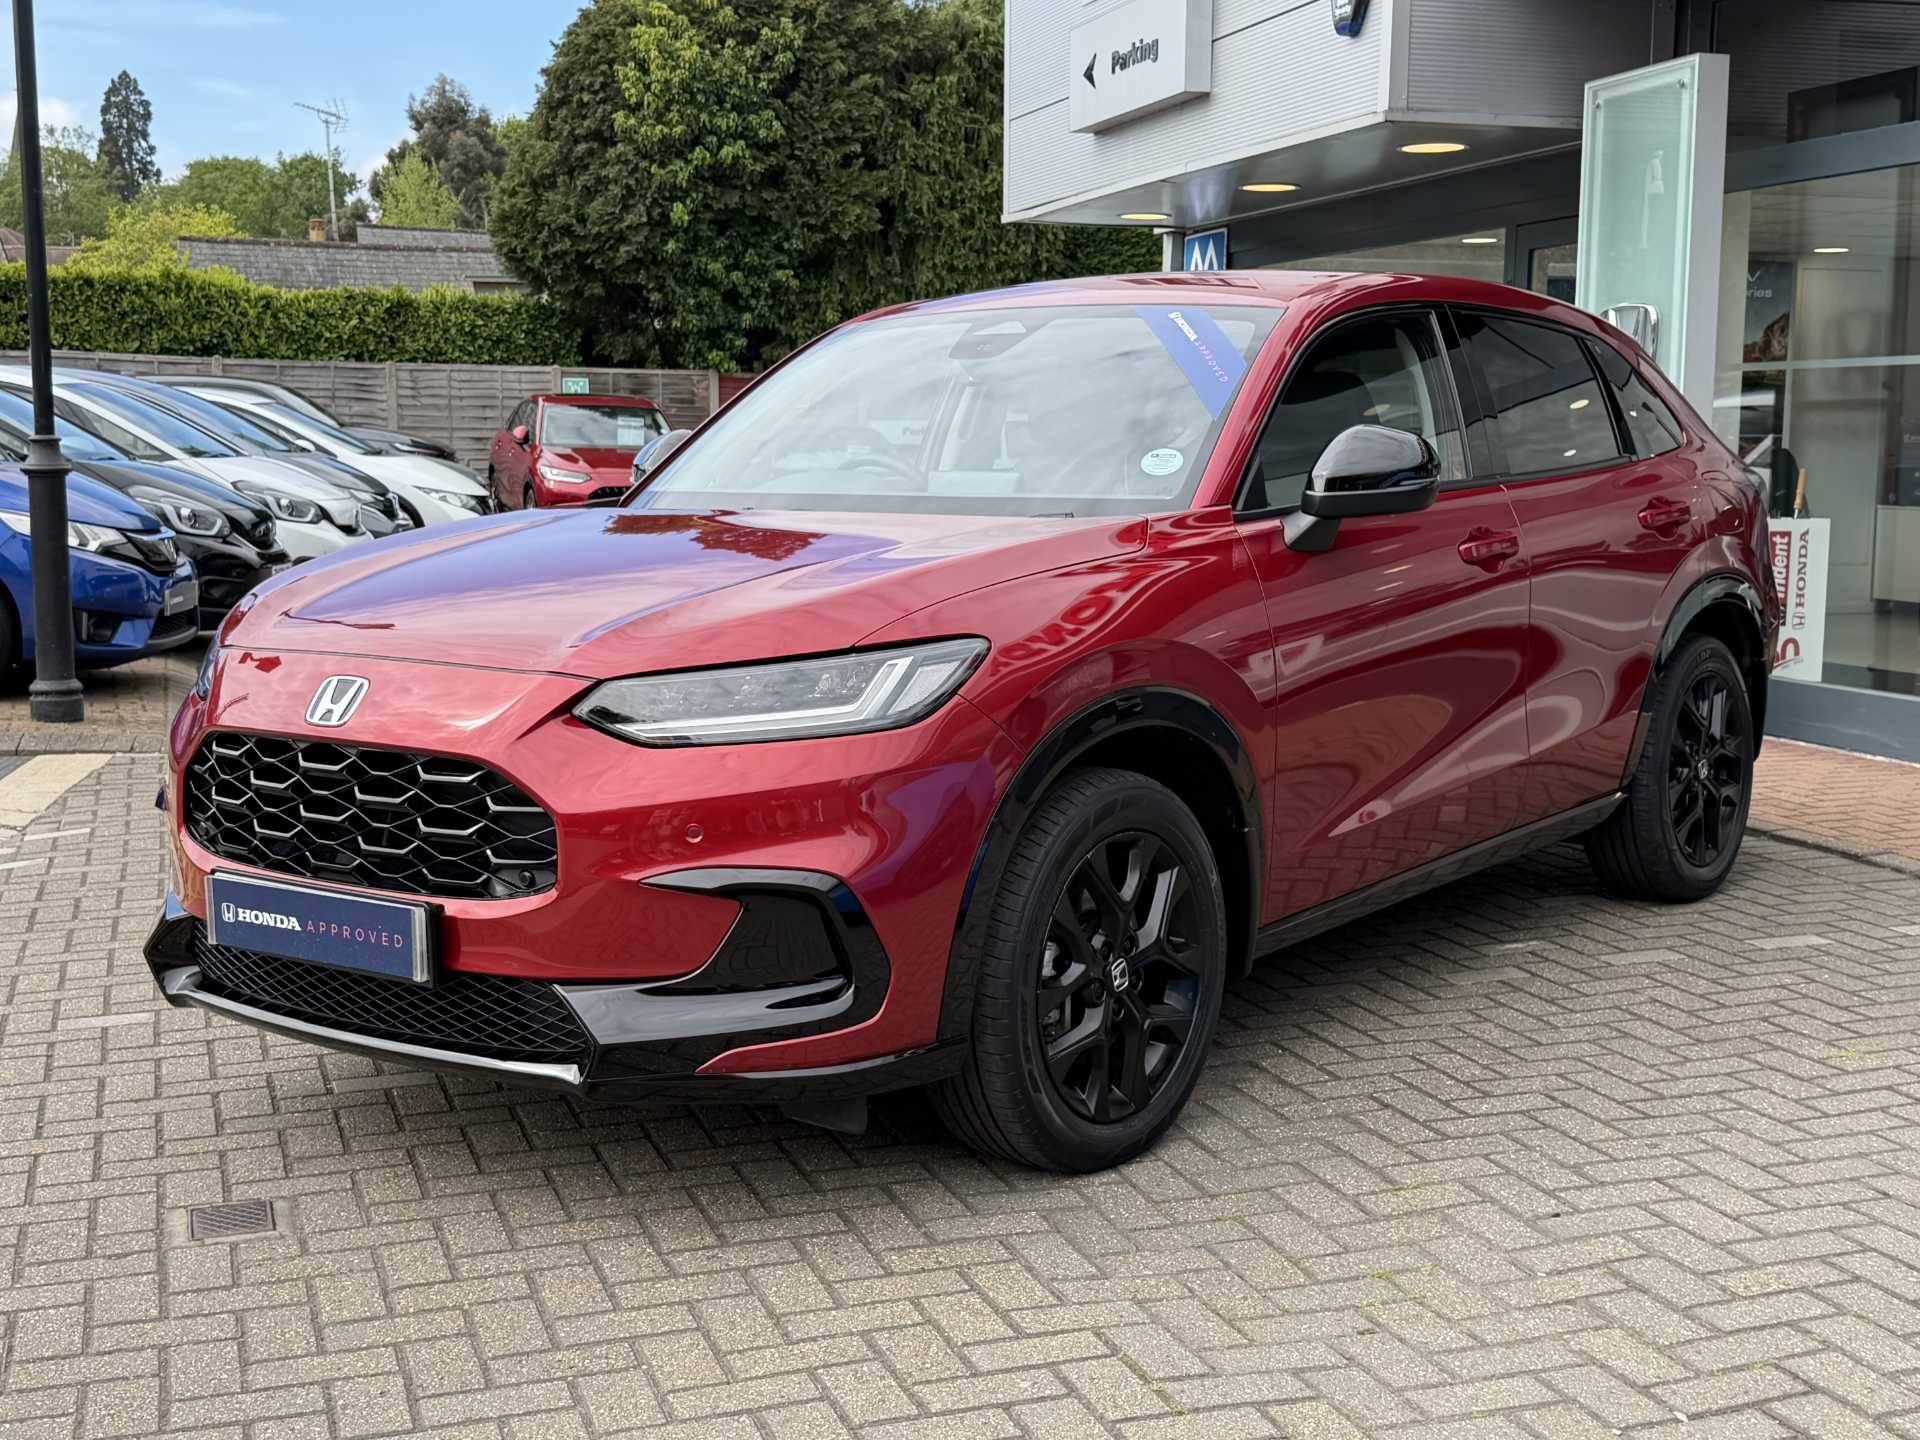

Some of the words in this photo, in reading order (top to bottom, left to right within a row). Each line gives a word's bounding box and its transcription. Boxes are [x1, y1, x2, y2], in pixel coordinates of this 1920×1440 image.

[1111, 38, 1159, 75] Parking
[1795, 528, 1810, 609] HONDA
[237, 907, 303, 932] HONDA
[306, 920, 404, 948] APPROVED
